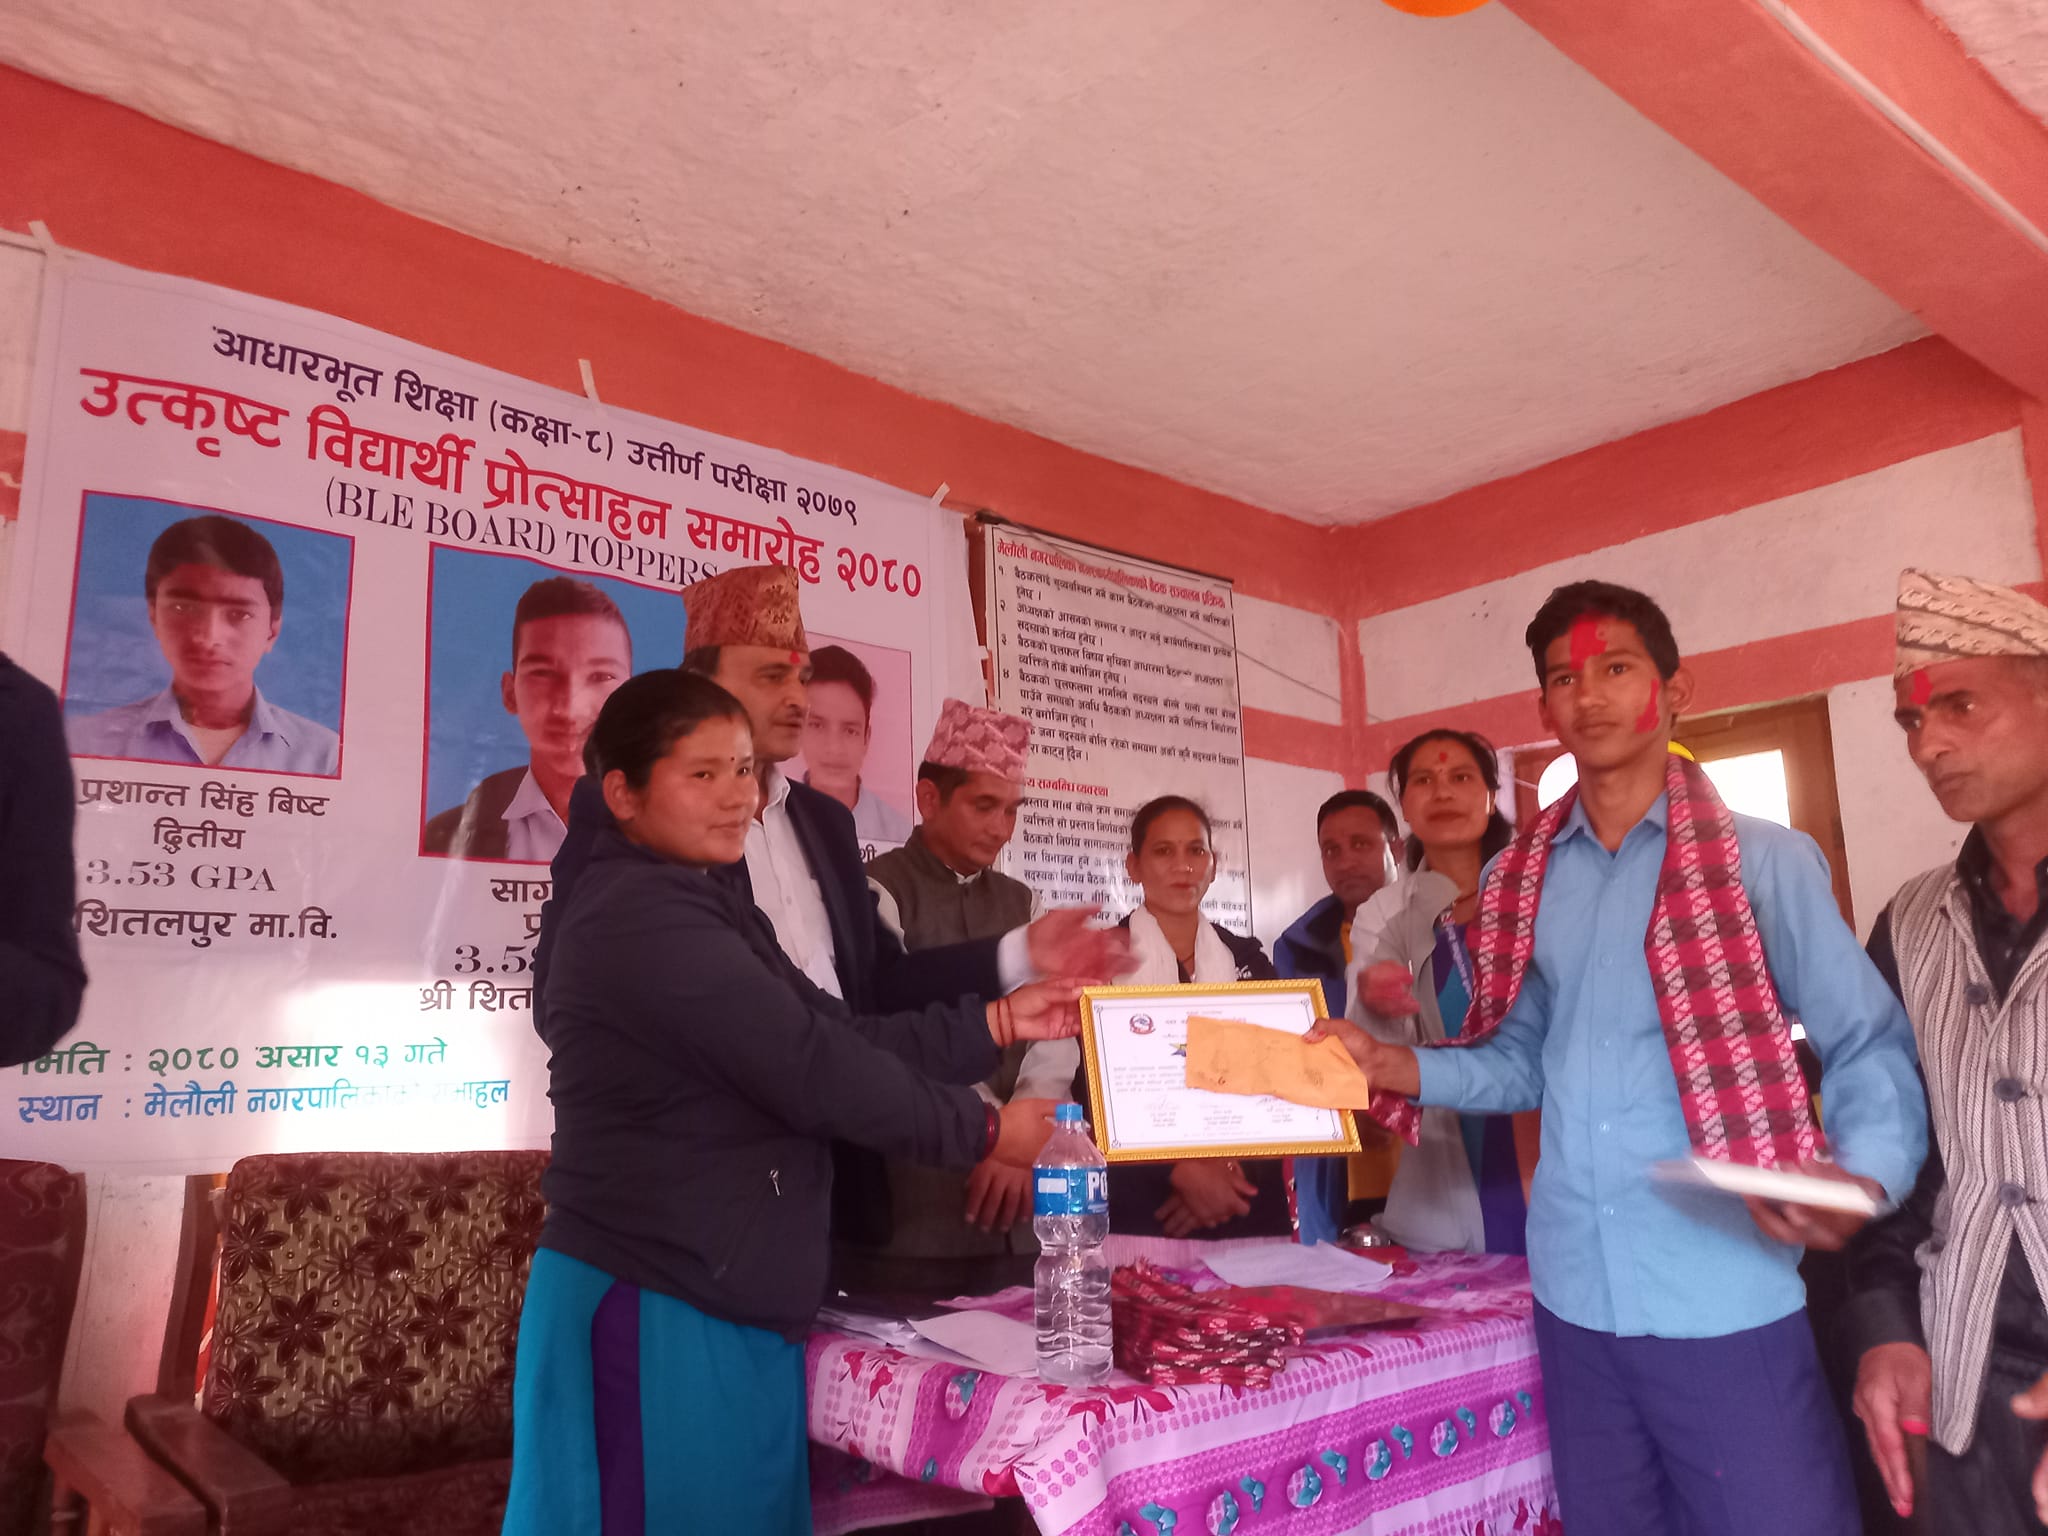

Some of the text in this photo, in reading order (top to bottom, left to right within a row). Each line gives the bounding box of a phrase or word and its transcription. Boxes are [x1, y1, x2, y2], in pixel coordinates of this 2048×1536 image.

[212, 327, 858, 526] आधारभूत शिक्षा (कक्षा-८) उत्तीर्ण परीक्षा २०७९
[79, 367, 922, 598] उत्कृष्ट विद्यार्थी प्रोत्साहन समारोह २०८०
[326, 476, 414, 530] (BLE
[424, 501, 556, 555] BOARD
[78, 778, 330, 817] प्रशान्त सिंह बिष्ट
[86, 859, 278, 892] 3.53 GPA
[490, 878, 553, 903] साग
[73, 899, 338, 948] शितलपुर मा.वि.
[420, 979, 534, 1013] श्री शित
[148, 1047, 240, 1077] २०८०
[255, 1044, 343, 1068] असार
[355, 1044, 389, 1067] १३
[404, 1036, 448, 1065] गते
[18, 1094, 103, 1123] स्थान
[144, 1080, 238, 1118] मेलौली
